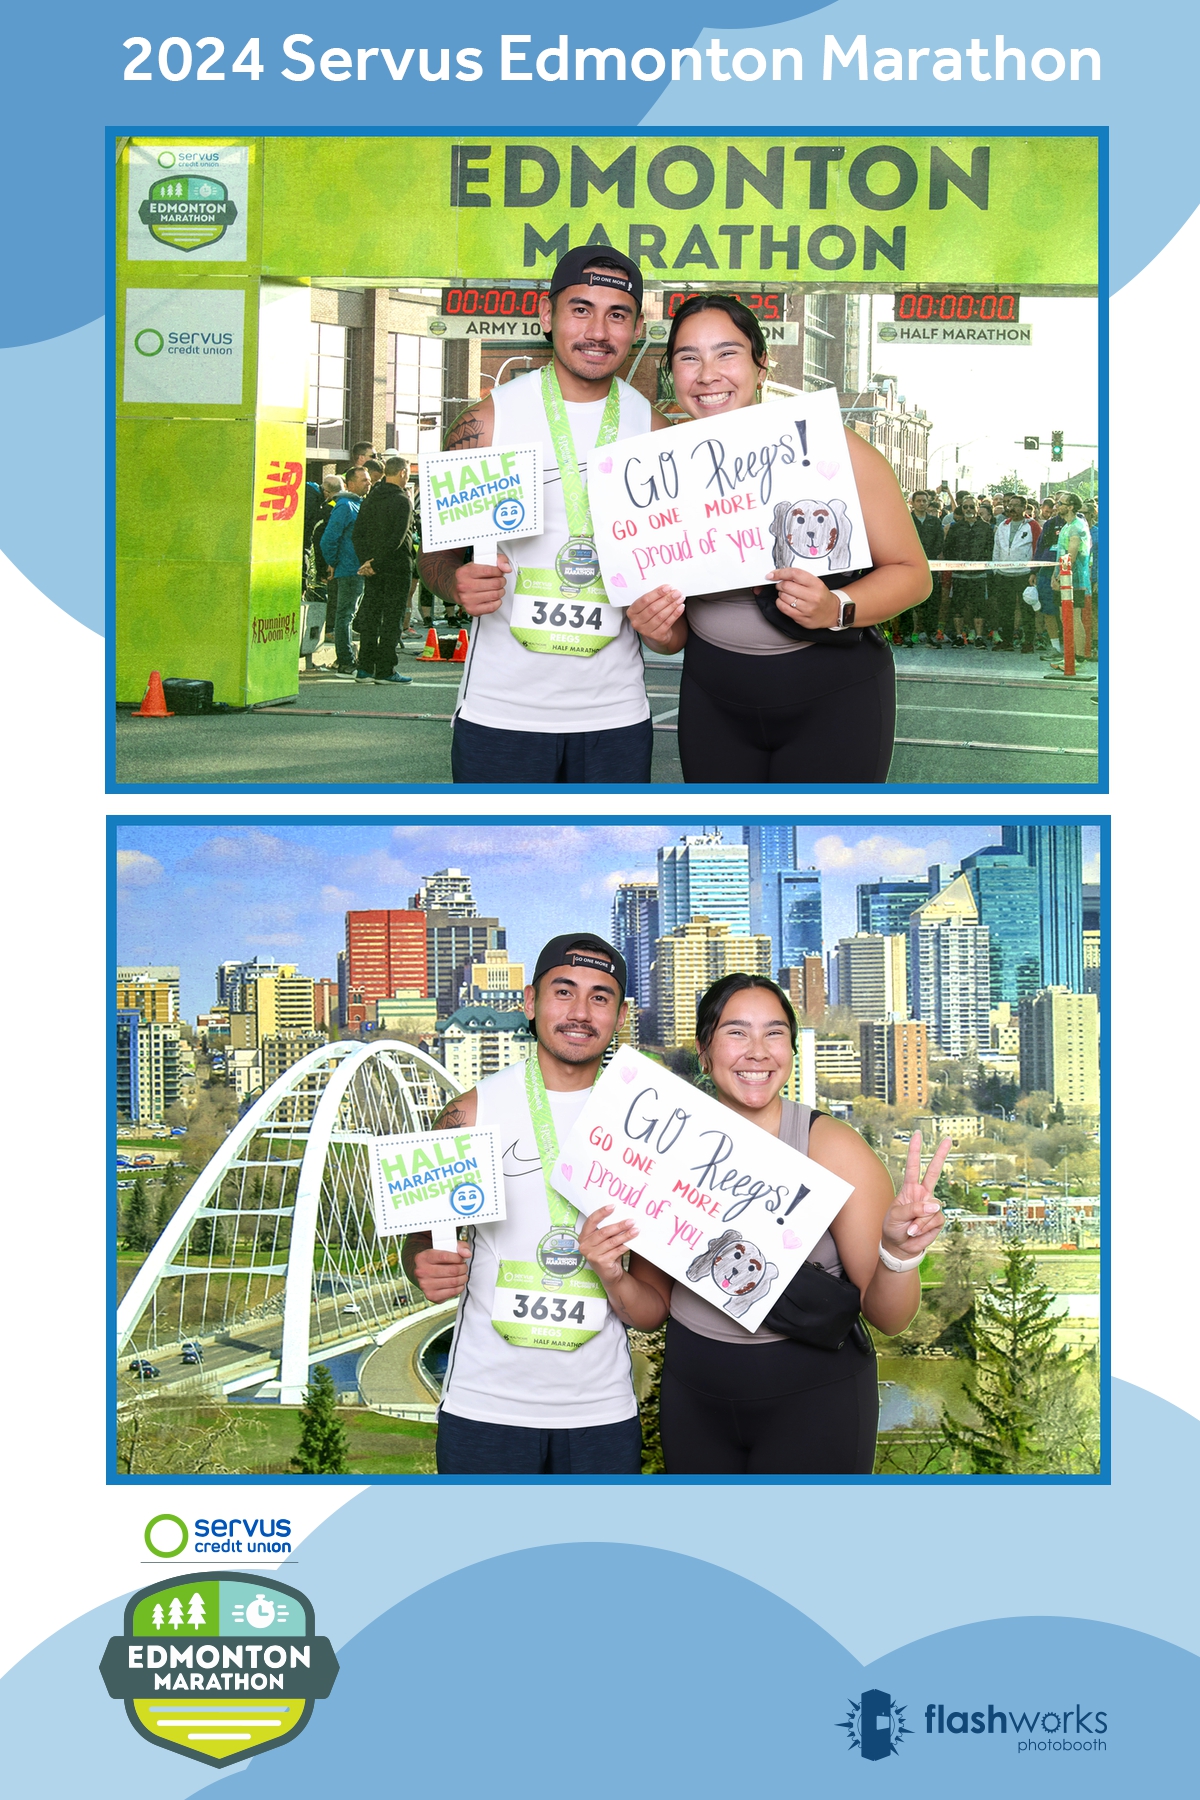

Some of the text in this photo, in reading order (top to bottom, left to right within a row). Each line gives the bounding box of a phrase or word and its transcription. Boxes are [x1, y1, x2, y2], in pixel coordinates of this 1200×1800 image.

[178, 152, 219, 161] servus
[449, 144, 990, 212] EDMONTON
[149, 203, 227, 214] EDMONTON
[160, 214, 215, 222] MARATHON
[168, 331, 233, 345] servus
[465, 321, 545, 335] ARMY 10
[900, 328, 939, 340] HALF
[942, 328, 1031, 341] MARATHON
[167, 345, 233, 355] credit union
[430, 451, 517, 499] HALF
[624, 449, 680, 508] GO
[690, 419, 811, 506] Reegs!
[436, 473, 521, 511] MARATHON
[438, 486, 525, 526] FINISHER!
[612, 493, 758, 541] GO ONE MORE
[632, 529, 694, 581] proud
[726, 527, 766, 563] you
[531, 600, 603, 631] 3634
[550, 634, 580, 644] REEGS
[552, 644, 600, 654] HALF MARATHO
[380, 1133, 472, 1183] HALF
[588, 1125, 613, 1151] GO
[622, 1147, 657, 1176] ONE
[672, 1178, 724, 1220] MORE
[623, 1087, 692, 1155] GO
[690, 1129, 811, 1226] Reegs!
[388, 1156, 478, 1195] MARATHON
[391, 1169, 483, 1210] FINISHER!
[583, 1160, 649, 1209] proud
[666, 1214, 704, 1251] you
[512, 1293, 585, 1324] 3634
[531, 1326, 562, 1338] REEGS
[551, 1340, 583, 1348] MARATHO
